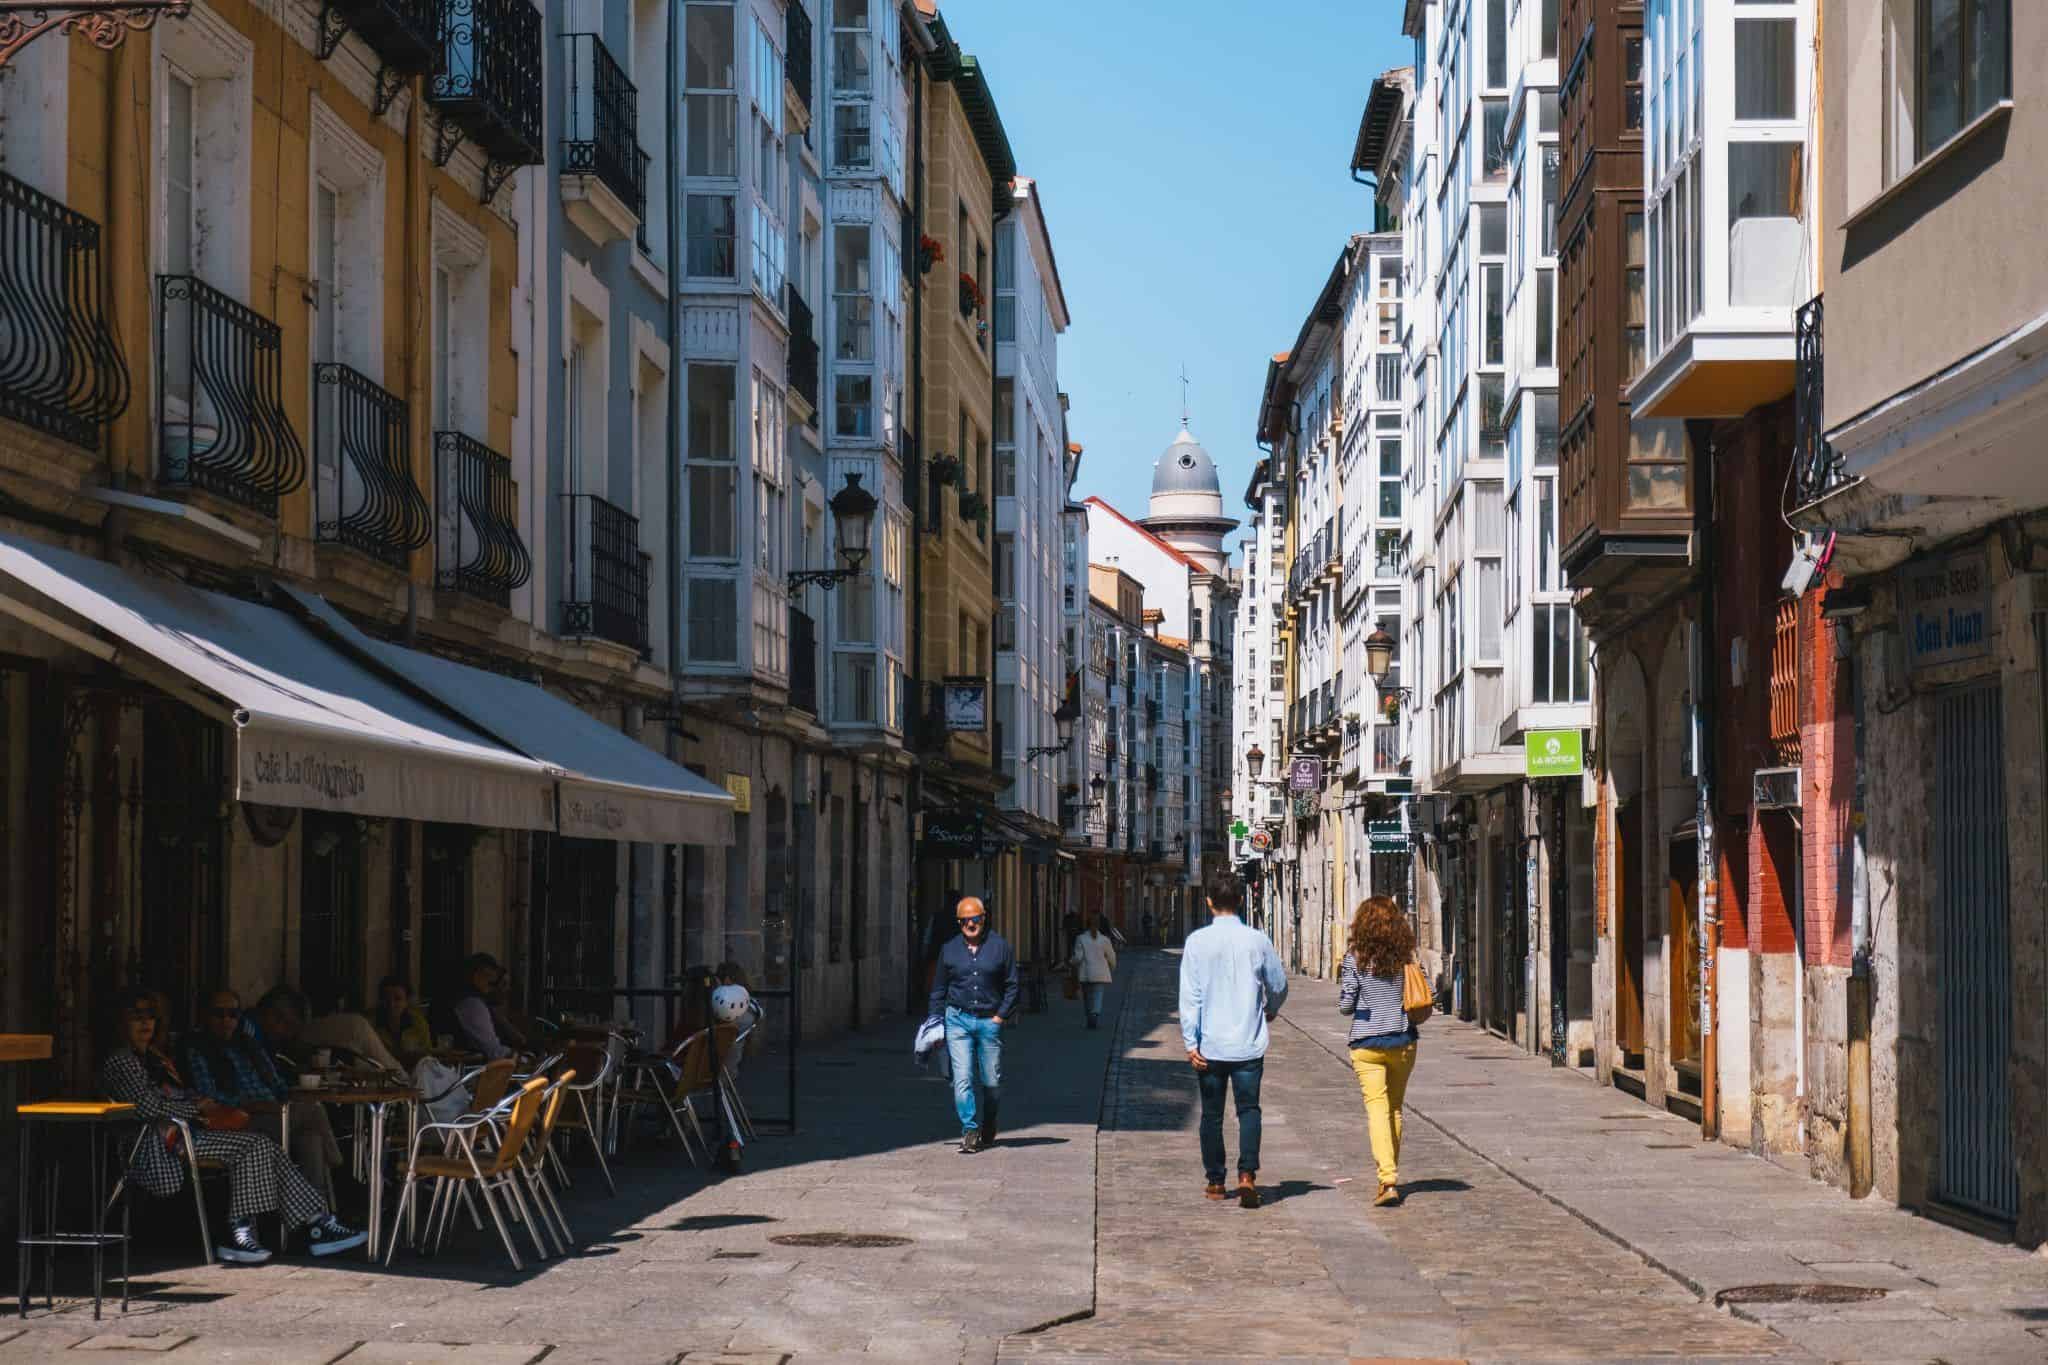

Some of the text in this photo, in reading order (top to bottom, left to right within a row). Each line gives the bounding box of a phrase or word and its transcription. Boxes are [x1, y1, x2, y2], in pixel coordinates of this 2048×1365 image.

[1915, 607, 1983, 655] San Juan
[1532, 756, 1544, 765] LA
